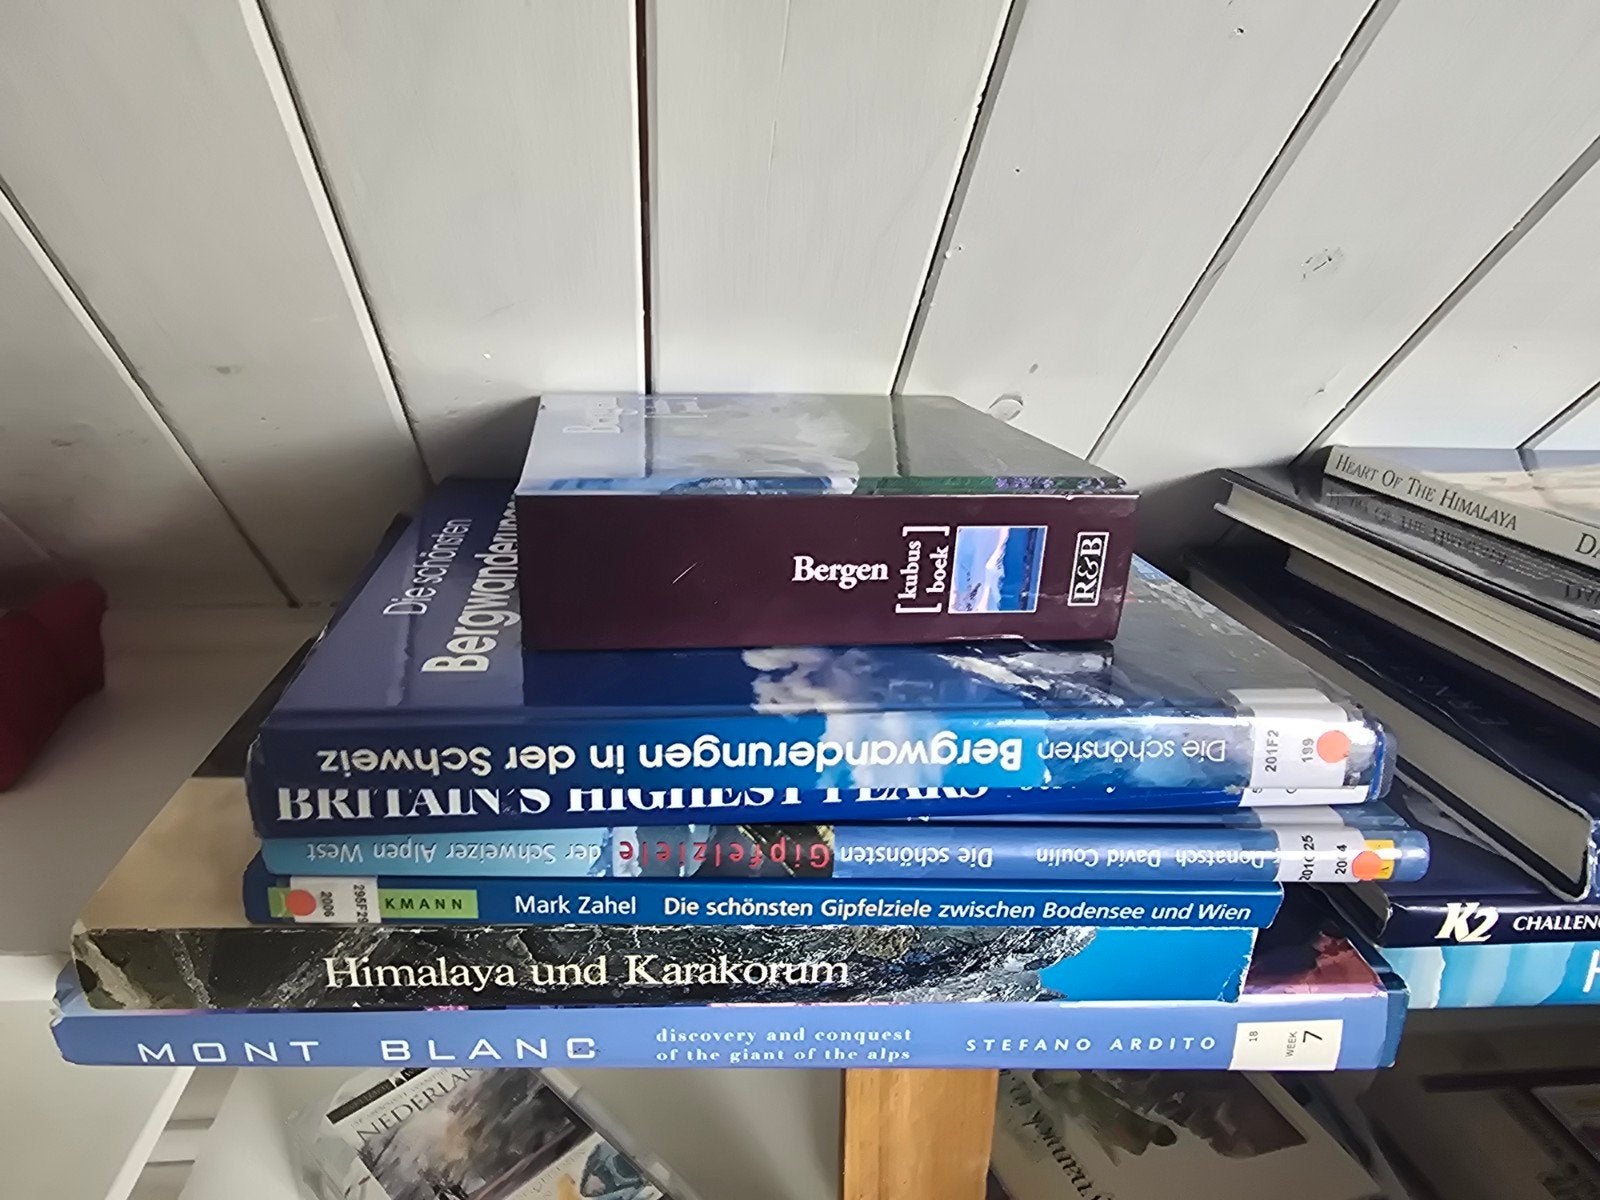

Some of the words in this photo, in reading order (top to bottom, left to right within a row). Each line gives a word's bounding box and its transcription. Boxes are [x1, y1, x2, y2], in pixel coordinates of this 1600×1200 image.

[1335, 454, 1379, 481] HEART
[1381, 469, 1403, 489] OF
[1406, 477, 1436, 502] THE
[1439, 488, 1516, 531] HIMALAYA
[383, 587, 437, 615] Die
[412, 519, 472, 584] schönsten
[792, 556, 889, 589] Bergen
[1074, 537, 1103, 600] R&B
[317, 747, 492, 779] Schweiz
[505, 745, 576, 776] der
[590, 744, 626, 776] in
[640, 733, 1022, 774] Bergwanderungen
[1038, 739, 1175, 764] schönsten
[1183, 739, 1226, 762] Die
[307, 843, 363, 863] West
[374, 836, 437, 863] Alpen
[446, 840, 556, 863] Schweizer
[564, 841, 601, 861] der
[620, 836, 829, 869] Gipfelziele
[841, 845, 950, 867] schönsten
[958, 846, 993, 868] Die
[1037, 847, 1099, 867] Coulin
[1107, 849, 1161, 867] David
[1176, 847, 1265, 868] Donatsch
[1335, 843, 1347, 875] 204
[515, 896, 570, 915] Mark
[578, 896, 637, 915] Zahel
[664, 897, 699, 916] Die
[706, 897, 813, 917] schönsten
[821, 899, 932, 924] Gipfelziele
[939, 900, 1034, 920] zwischen
[1042, 901, 1145, 919] Bodensee
[1151, 902, 1193, 920] und
[1198, 903, 1251, 920] Wien
[1434, 902, 1499, 942] K2
[1512, 914, 1600, 931] CHALLEN
[325, 956, 515, 993] Himalaya
[531, 954, 607, 986] und
[625, 953, 850, 986] Karakorum
[656, 1028, 756, 1044] discovery
[766, 1027, 805, 1042] and
[814, 1028, 912, 1046] conquest
[965, 1037, 1092, 1052] STEFANO
[1110, 1036, 1217, 1051] ARDITO
[1286, 1031, 1297, 1058] WEEK
[1302, 1030, 1323, 1043] 7
[137, 1041, 319, 1064] MONT
[381, 1037, 597, 1061] BLANC
[656, 1049, 679, 1061] of
[687, 1049, 723, 1061] the
[730, 1049, 784, 1063] giant
[794, 1048, 817, 1061] of
[825, 1048, 860, 1061] the
[868, 1048, 910, 1063] alps
